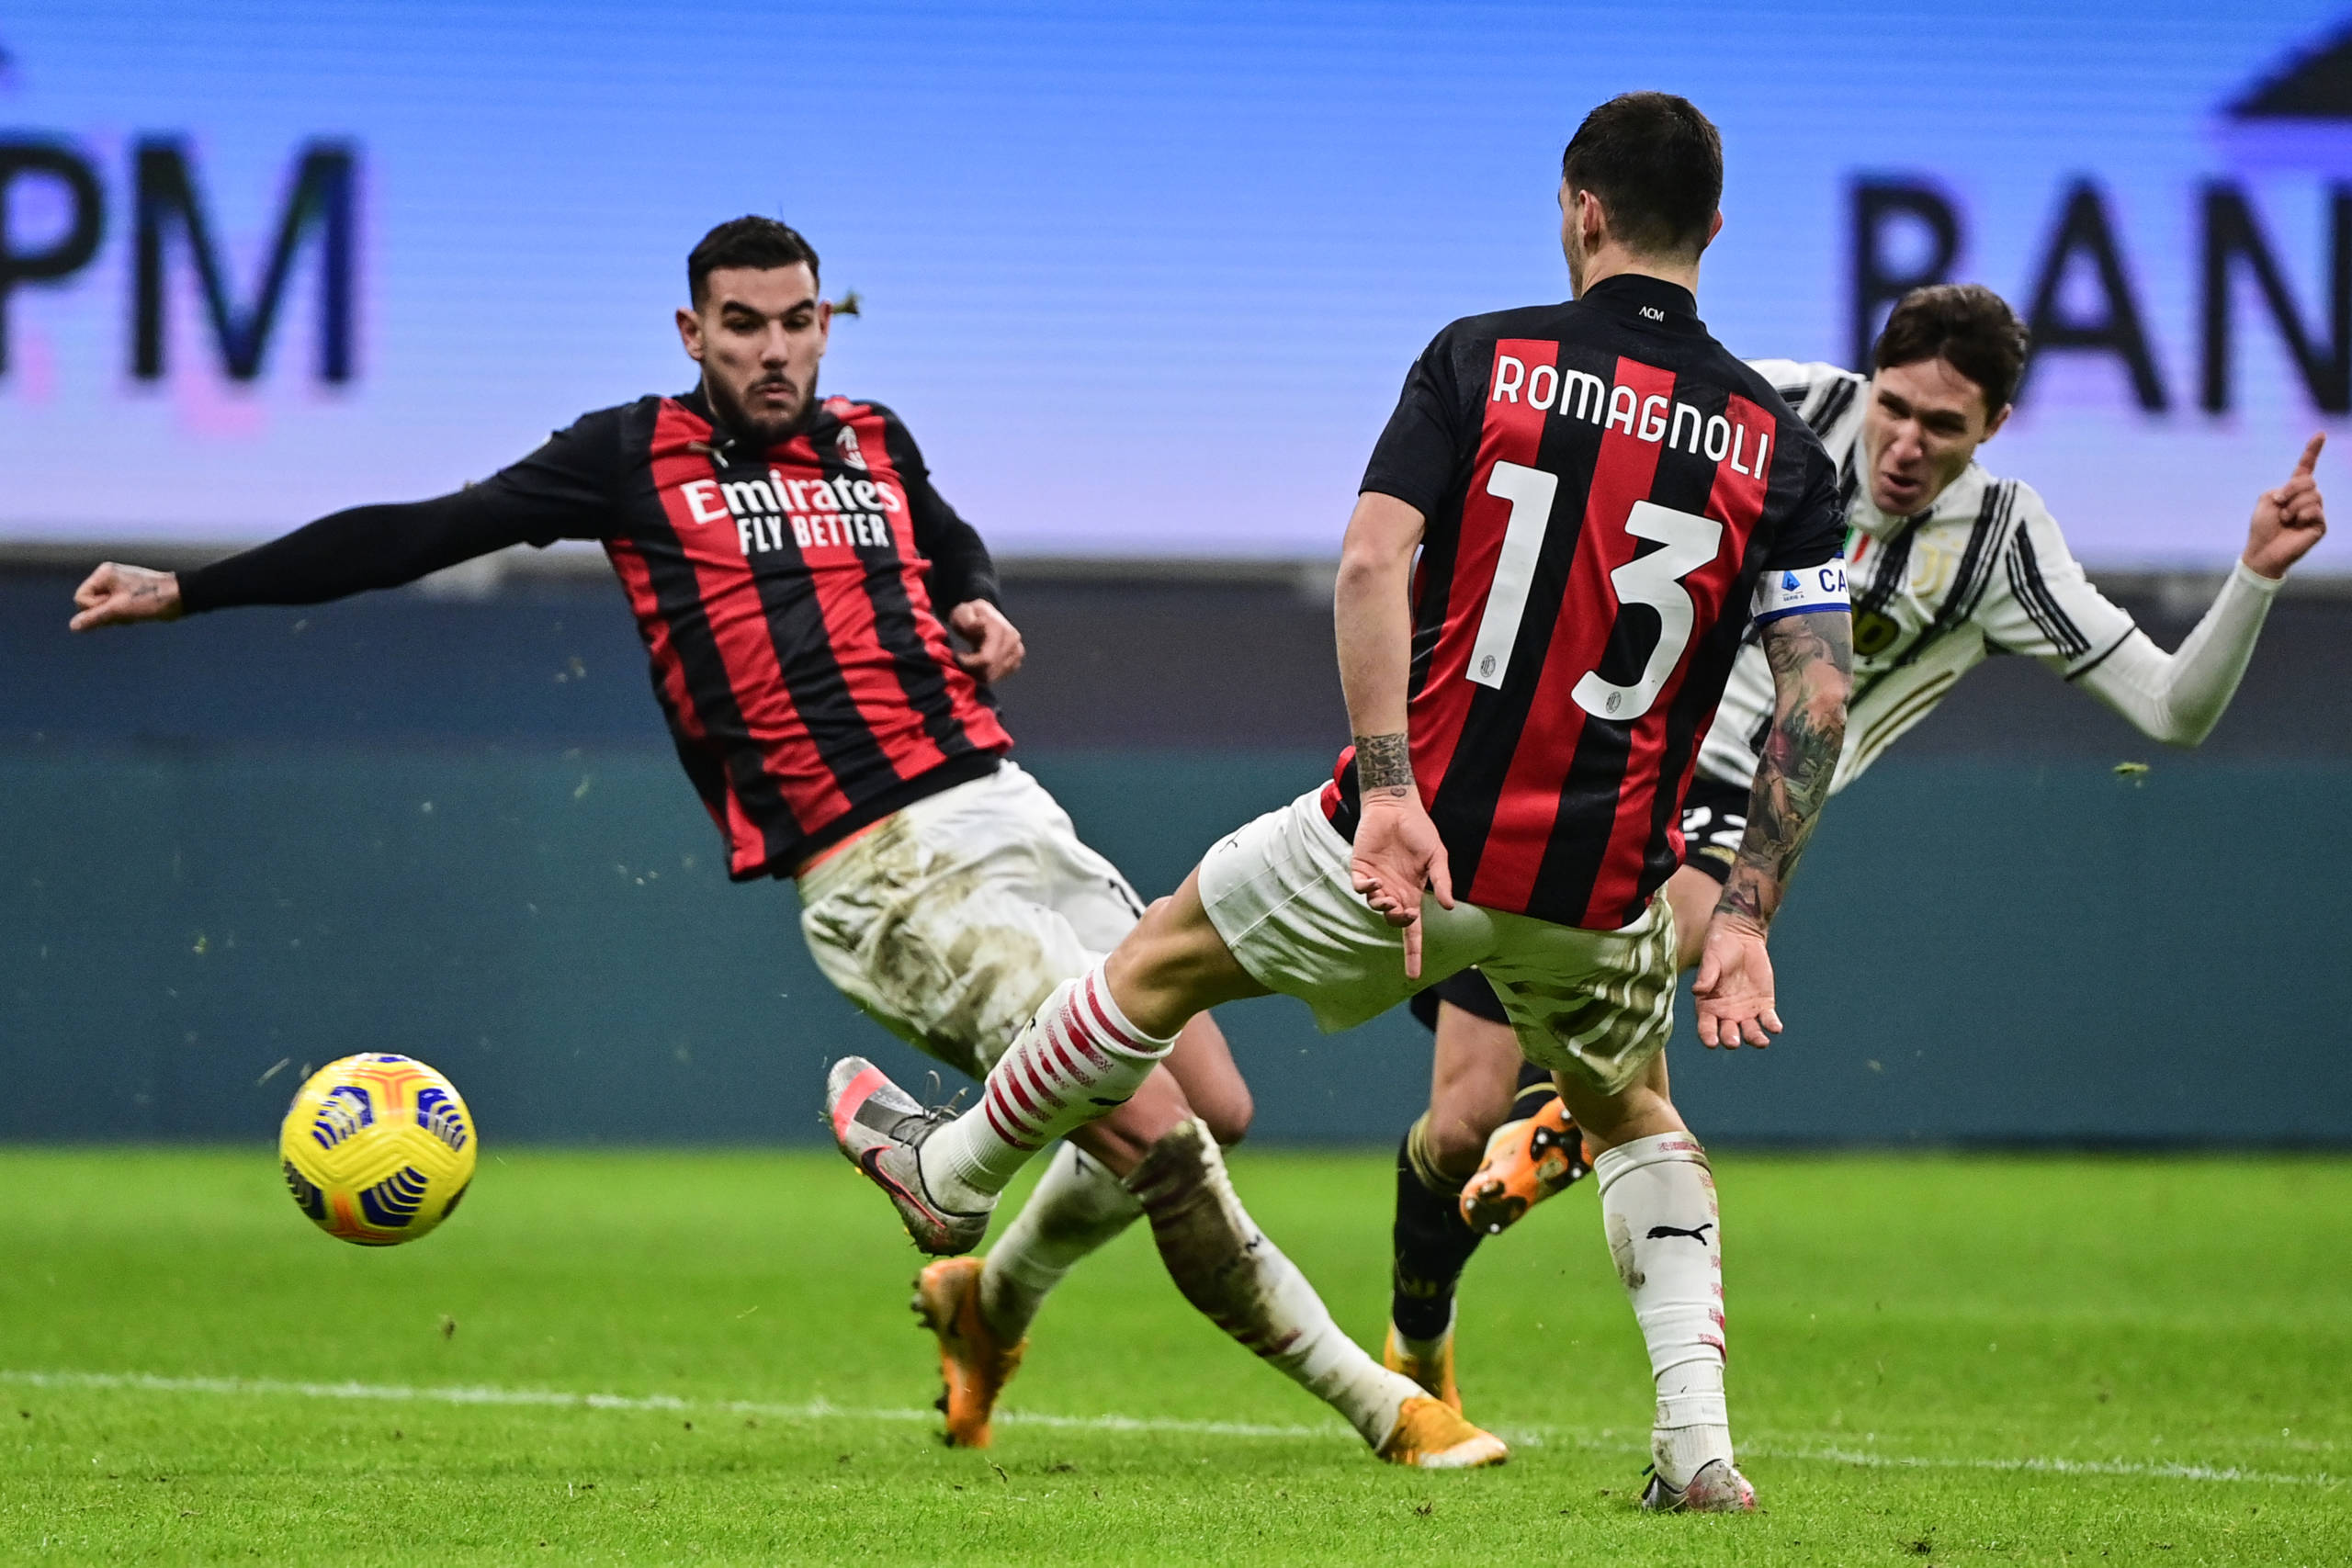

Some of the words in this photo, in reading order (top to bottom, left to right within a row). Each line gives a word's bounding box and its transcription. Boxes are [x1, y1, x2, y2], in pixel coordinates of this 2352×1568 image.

[1491, 354, 1770, 480] ROMAGNOLI
[680, 468, 901, 525] Emirates
[736, 515, 784, 556] FLY
[791, 513, 890, 548] BETTER
[1464, 459, 1724, 721] 13
